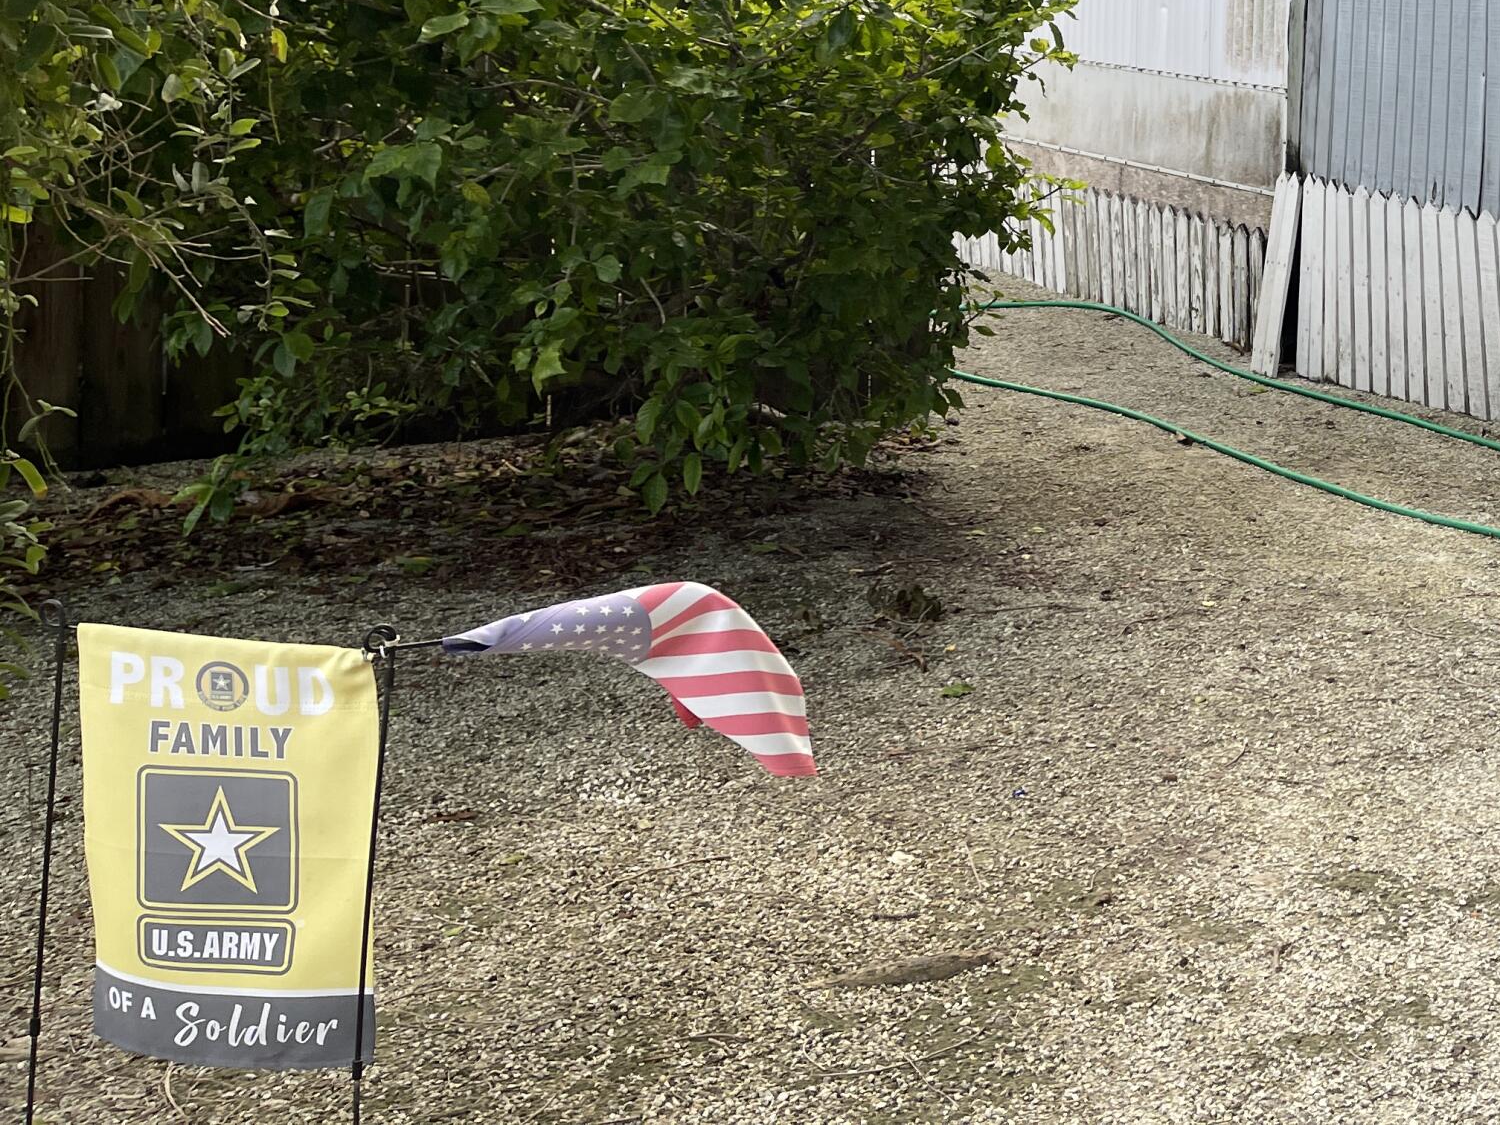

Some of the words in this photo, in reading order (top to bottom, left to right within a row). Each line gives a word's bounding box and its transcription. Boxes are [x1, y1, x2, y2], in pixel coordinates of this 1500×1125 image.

[149, 719, 293, 760] FAMILY
[108, 986, 133, 1013] OF
[140, 996, 157, 1020] A
[173, 1001, 338, 1047] Soldier
